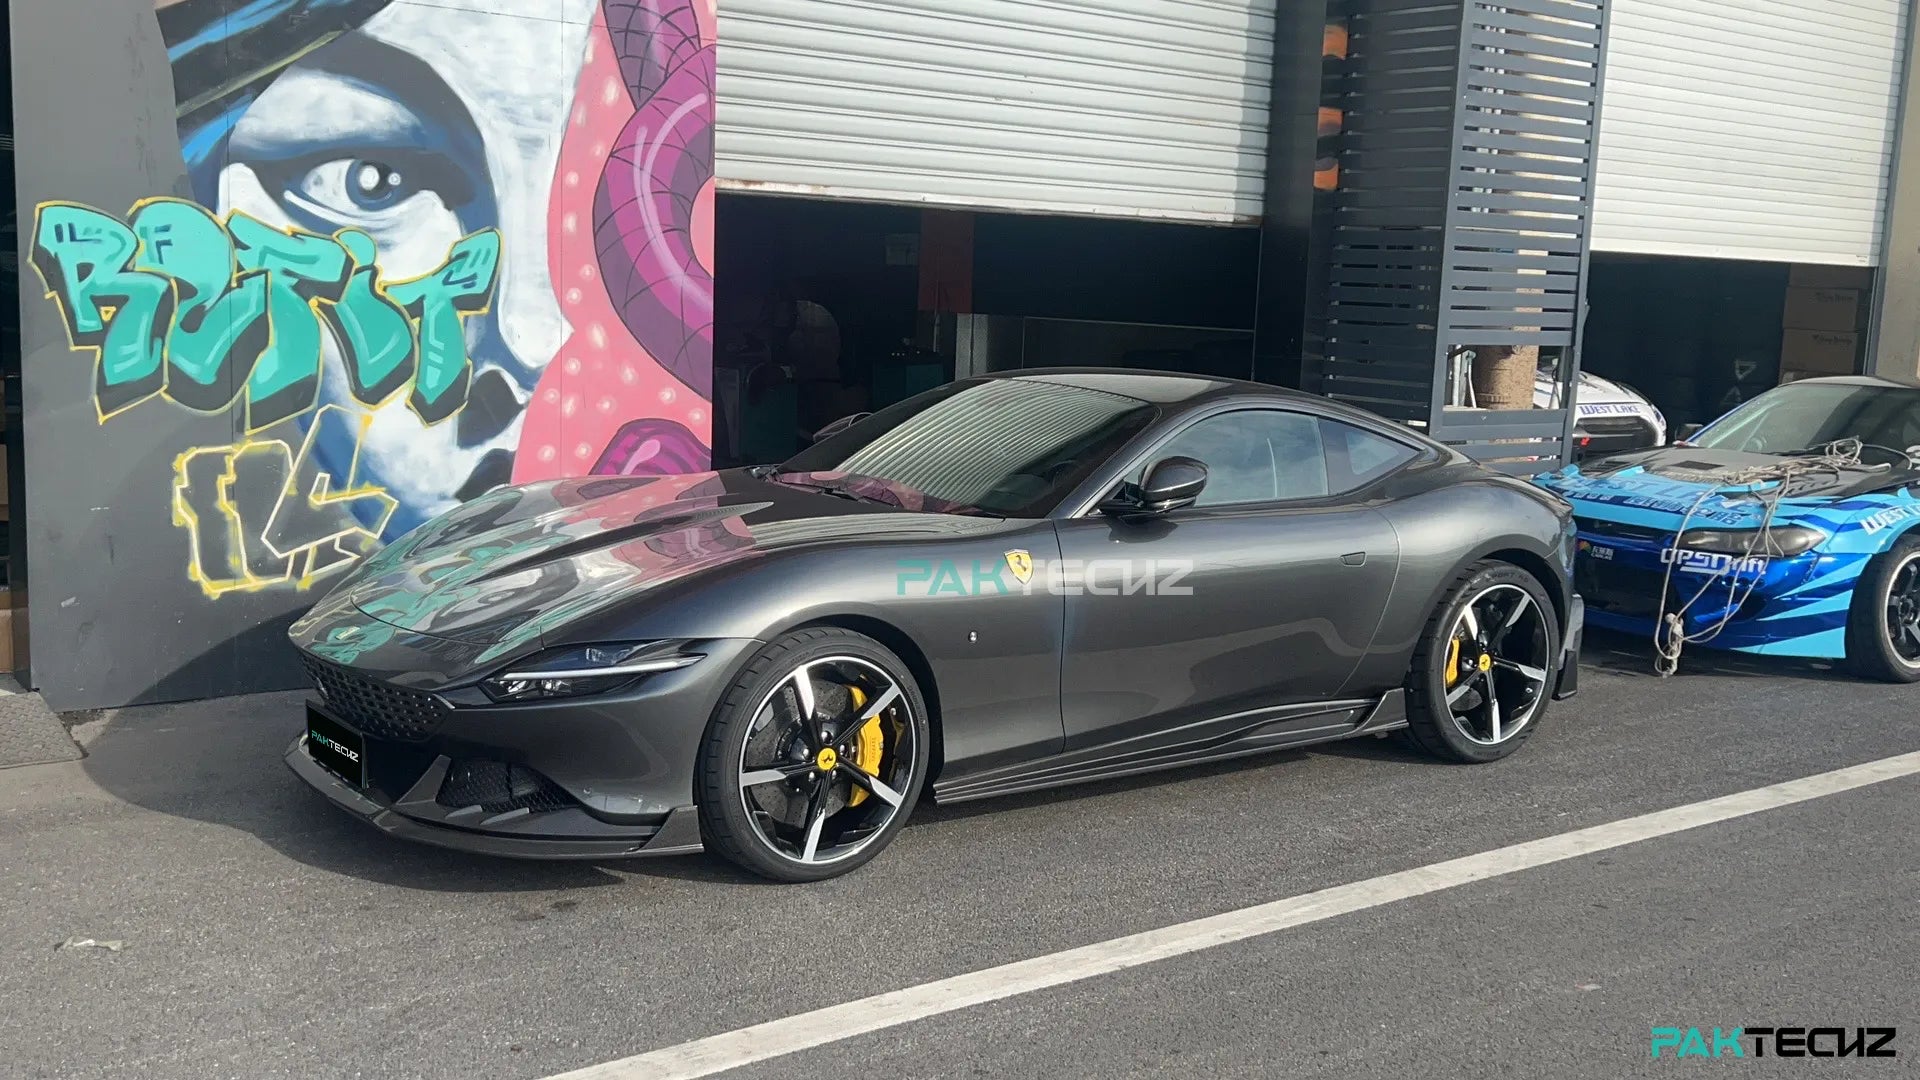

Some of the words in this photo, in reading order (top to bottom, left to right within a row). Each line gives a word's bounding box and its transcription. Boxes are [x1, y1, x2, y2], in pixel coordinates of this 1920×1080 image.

[1580, 404, 1612, 415] WEST
[1613, 403, 1641, 414] LAKE
[1860, 505, 1910, 535] WEST
